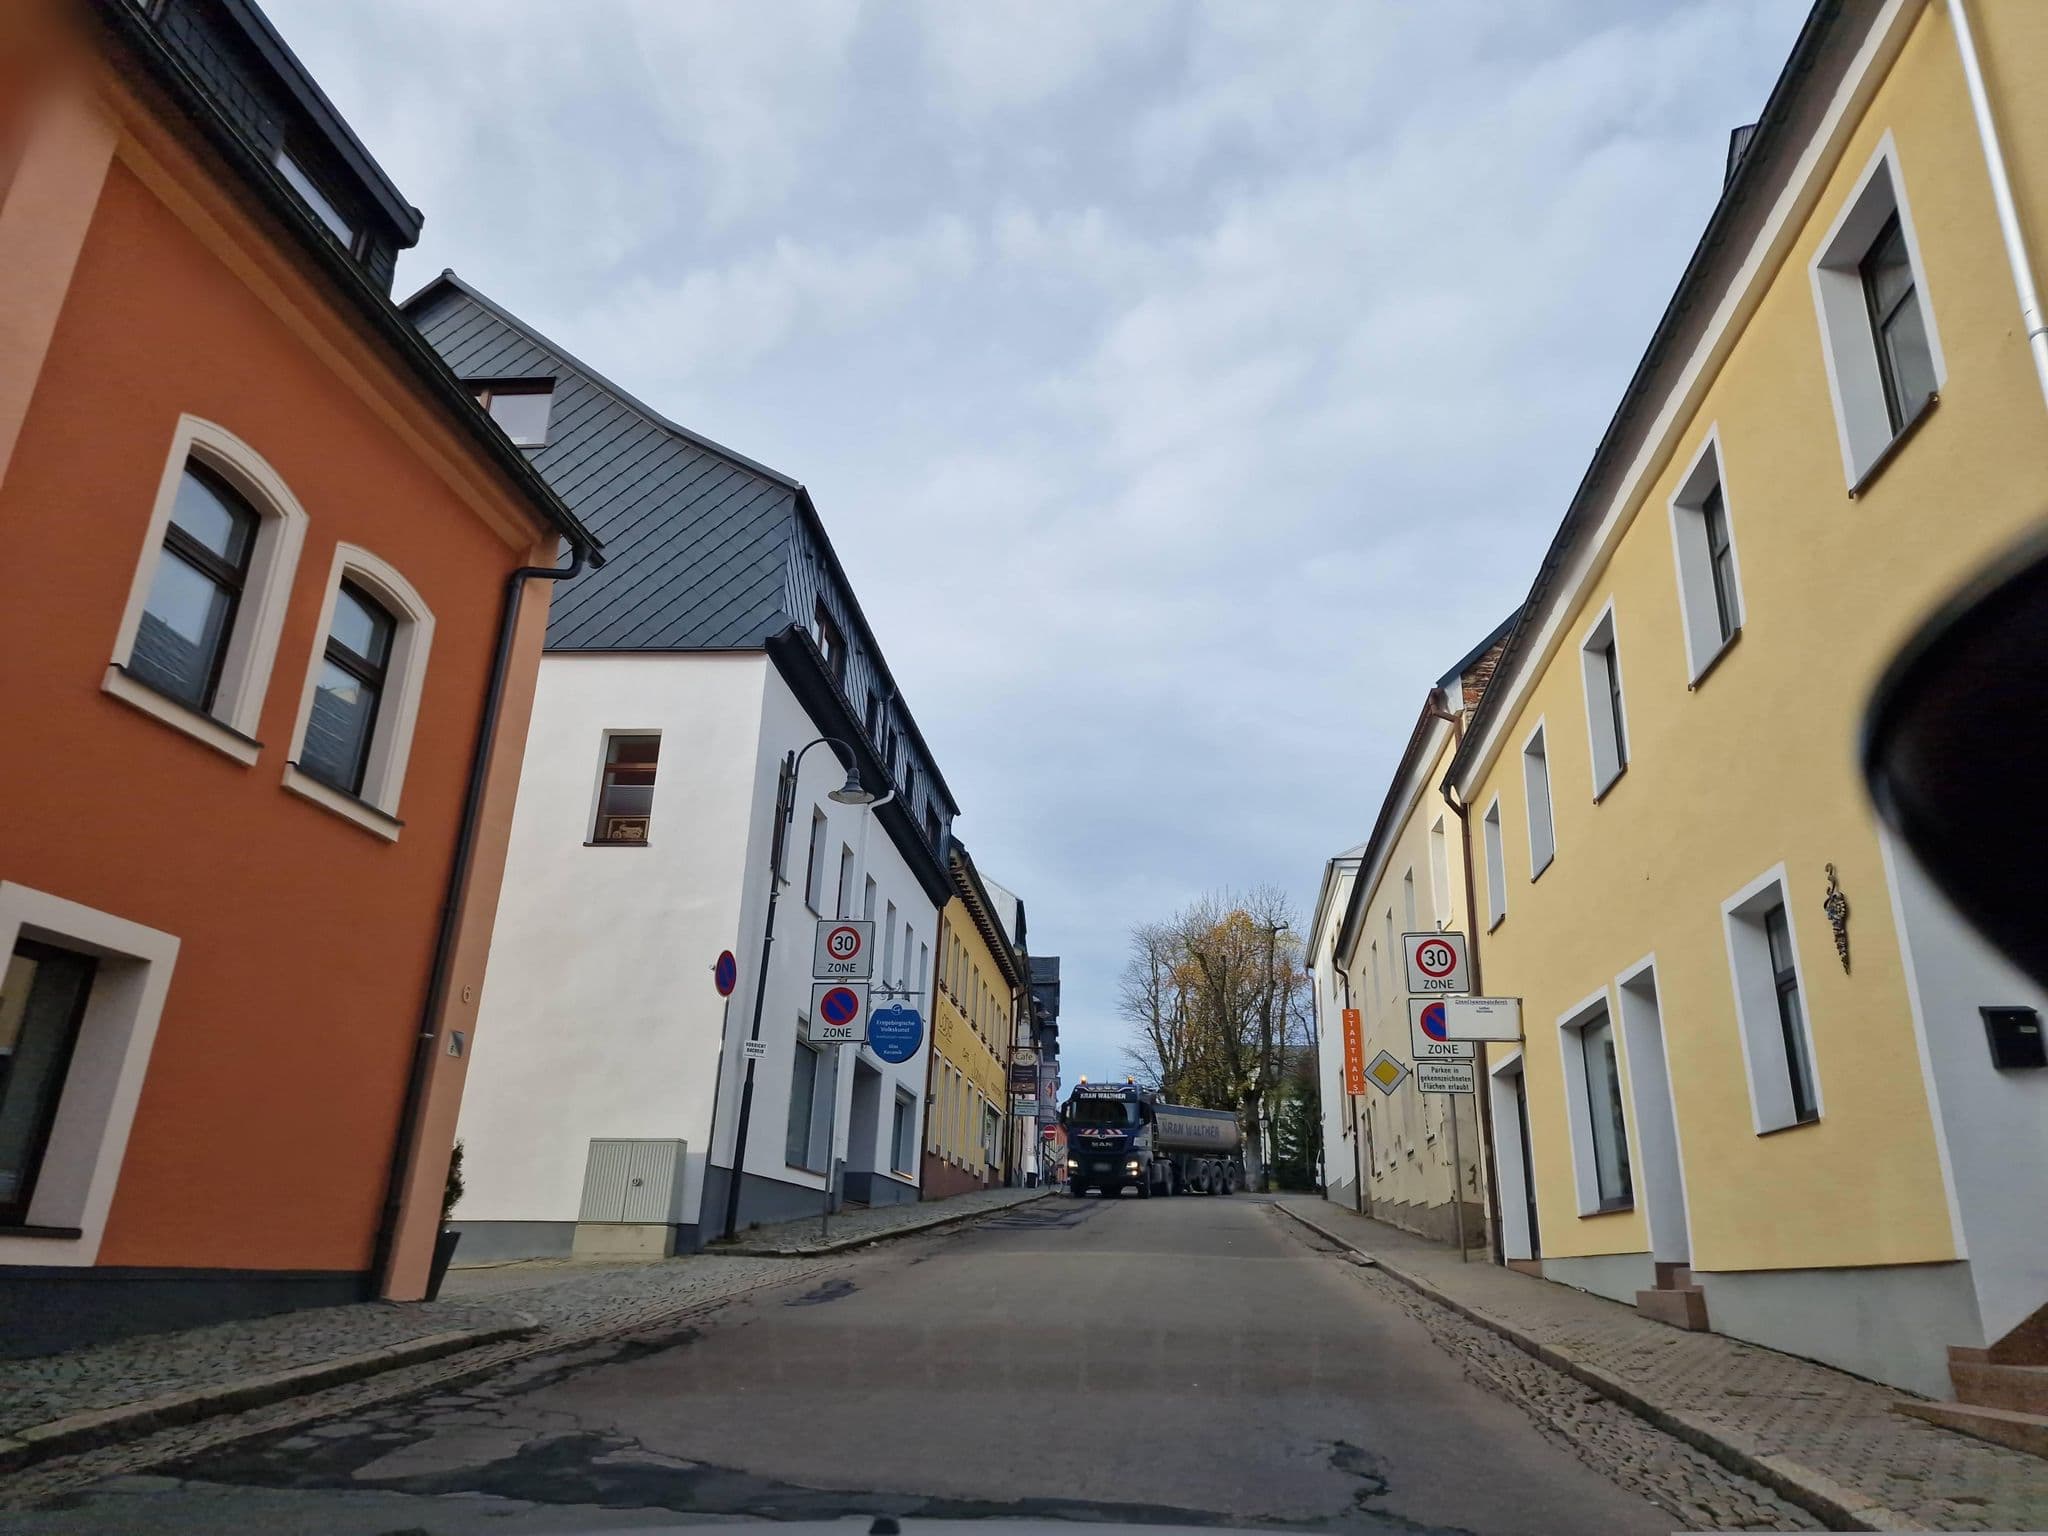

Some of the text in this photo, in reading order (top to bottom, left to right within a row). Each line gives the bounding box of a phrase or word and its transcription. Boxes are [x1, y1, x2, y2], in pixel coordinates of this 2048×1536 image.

[834, 935, 854, 951] 30
[1425, 950, 1448, 966] 30
[827, 963, 857, 972] ZONE
[1424, 980, 1454, 989] ZONE
[822, 1028, 852, 1038] ZONE
[1347, 1011, 1359, 1091] STARTHAUS
[1428, 1045, 1459, 1054] ZONE
